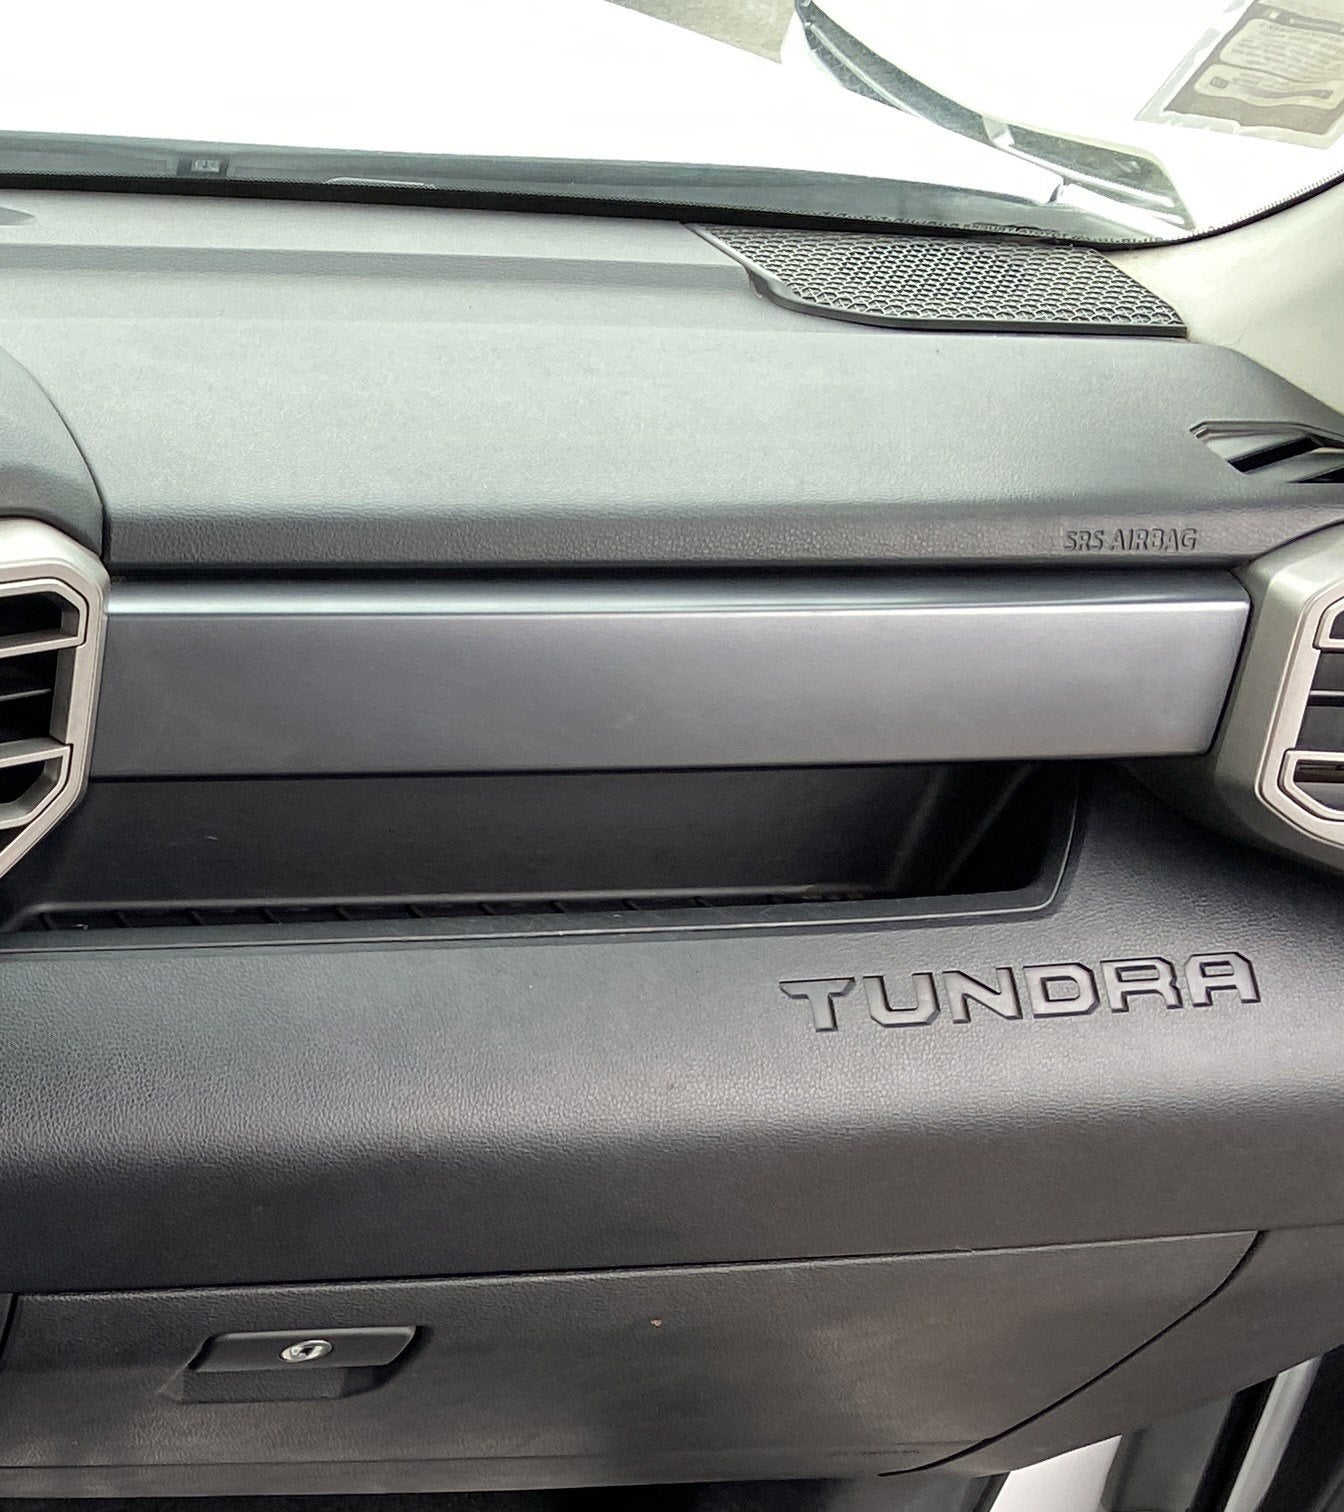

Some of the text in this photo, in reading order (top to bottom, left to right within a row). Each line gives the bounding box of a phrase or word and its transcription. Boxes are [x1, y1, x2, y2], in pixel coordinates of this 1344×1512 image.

[1063, 528, 1199, 552] SRS AIRBAG
[779, 950, 1262, 1032] TUNDRA
